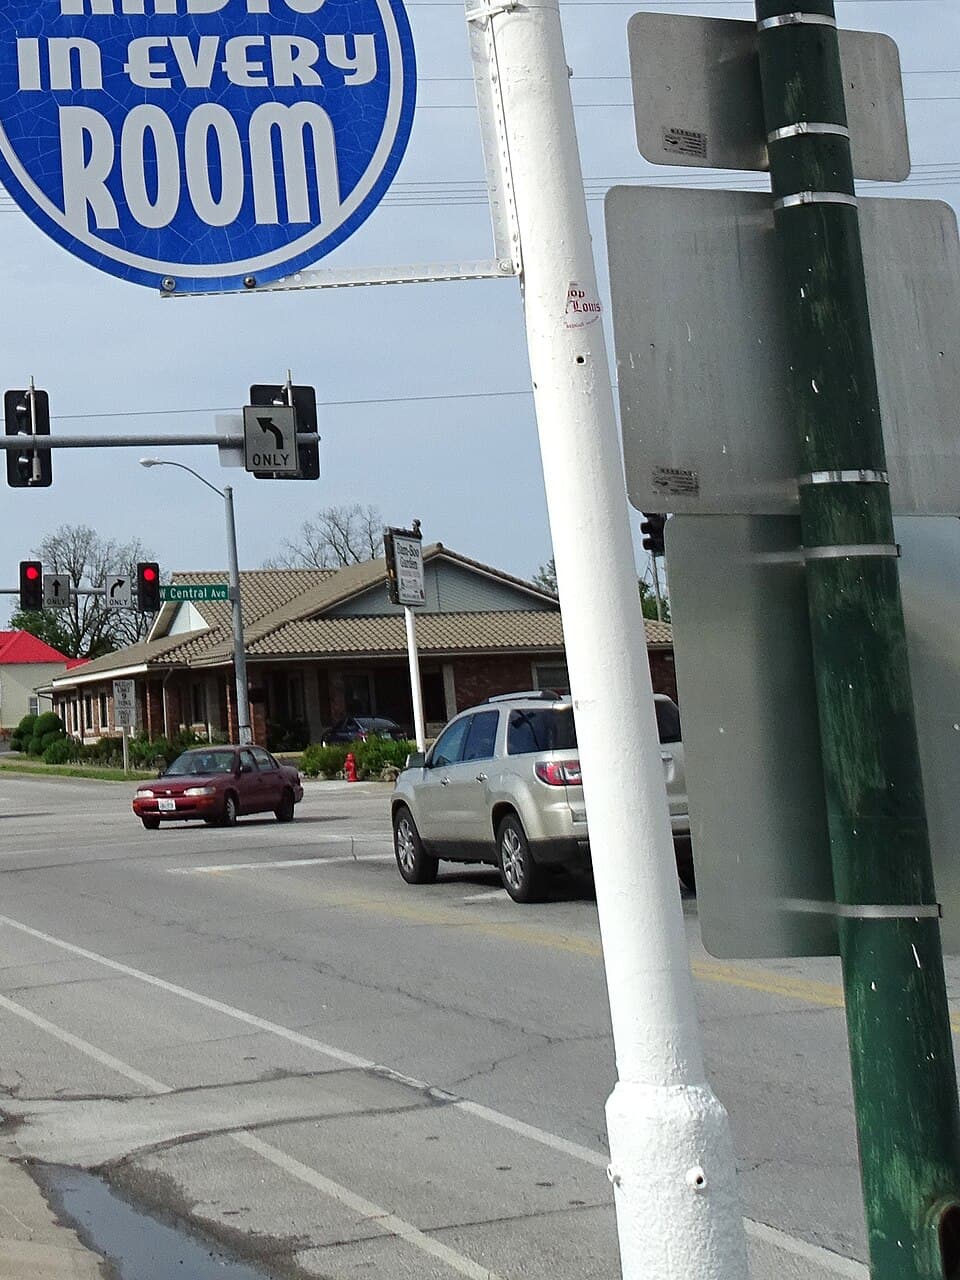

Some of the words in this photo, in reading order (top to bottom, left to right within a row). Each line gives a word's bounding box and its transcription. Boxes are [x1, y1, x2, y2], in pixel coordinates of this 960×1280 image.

[59, 101, 341, 230] ROOM
[252, 453, 289, 466] ONLY
[170, 587, 207, 599] Central
[211, 588, 226, 598] Ave
